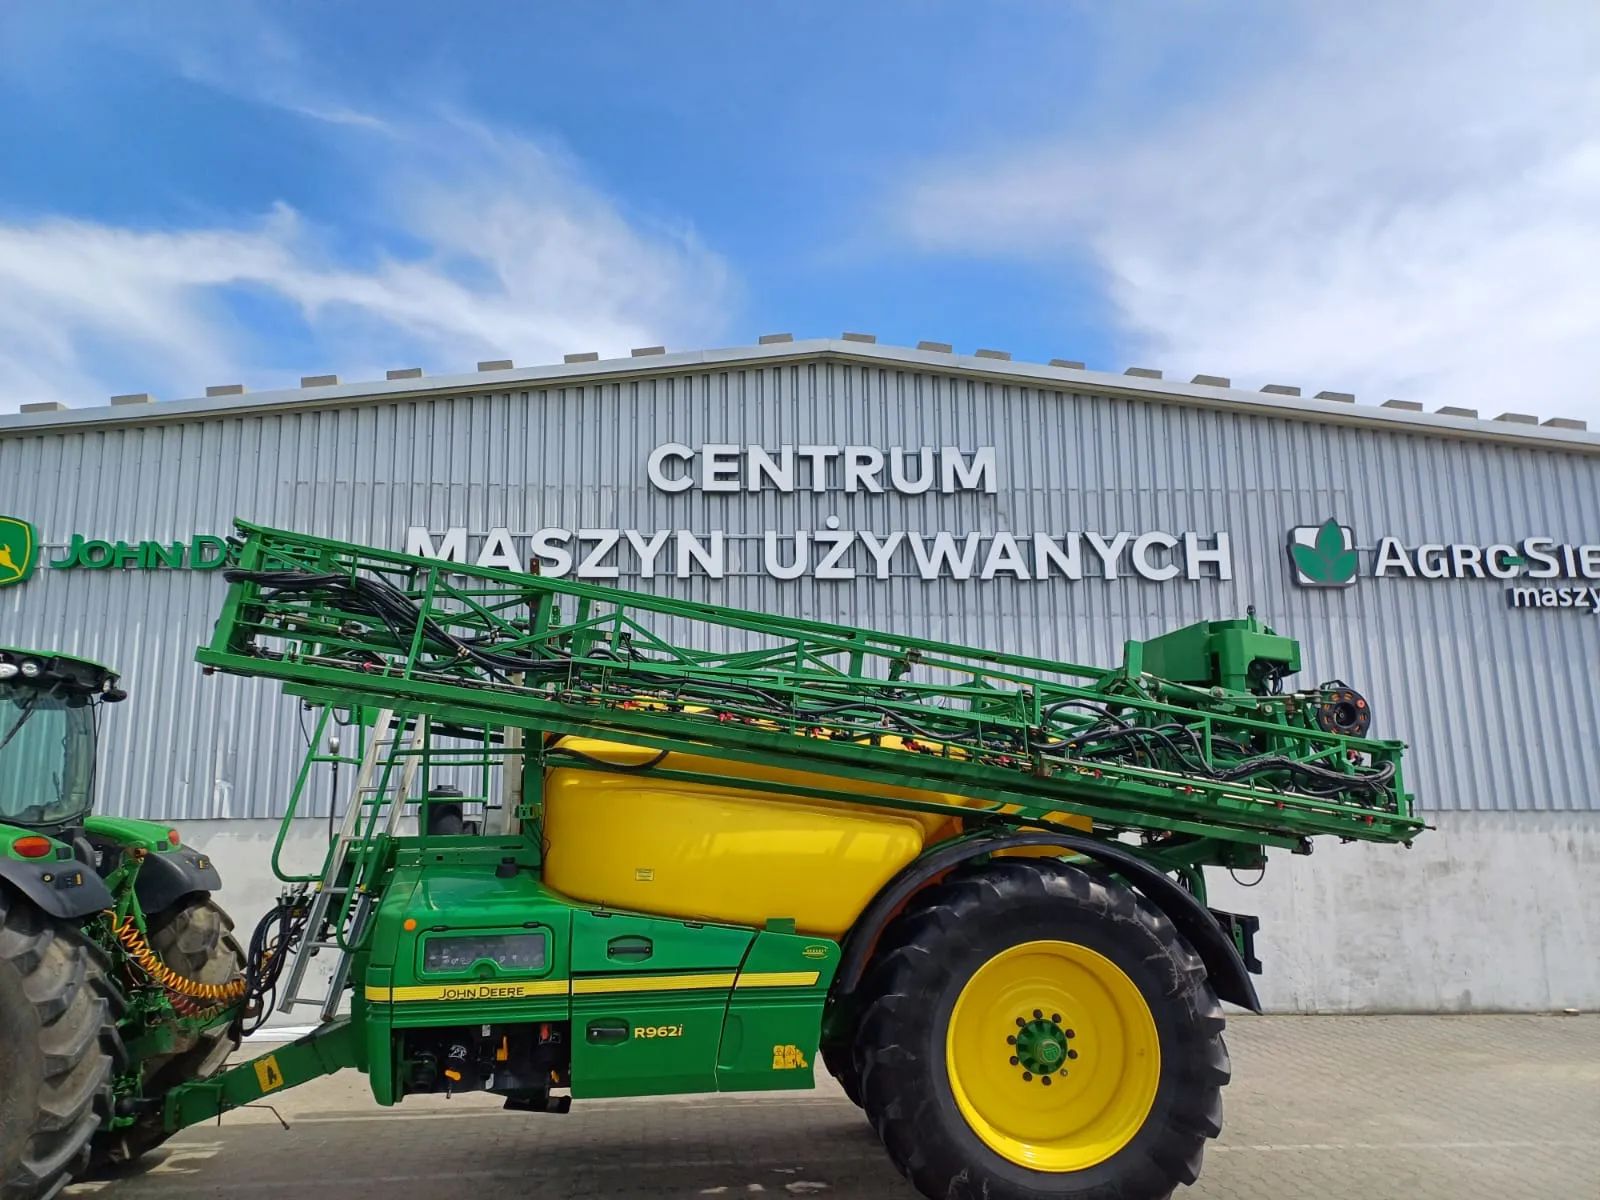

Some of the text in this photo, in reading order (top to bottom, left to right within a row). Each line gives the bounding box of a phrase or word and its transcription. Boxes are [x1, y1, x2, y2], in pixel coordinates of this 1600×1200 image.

[648, 442, 997, 494] CENTRUM
[51, 534, 183, 569] JOHN
[406, 526, 725, 580] MASZYN
[764, 516, 1233, 582] UŻYWANYCH
[439, 986, 525, 999] JOHN DEERE
[634, 1023, 683, 1039] R962i
